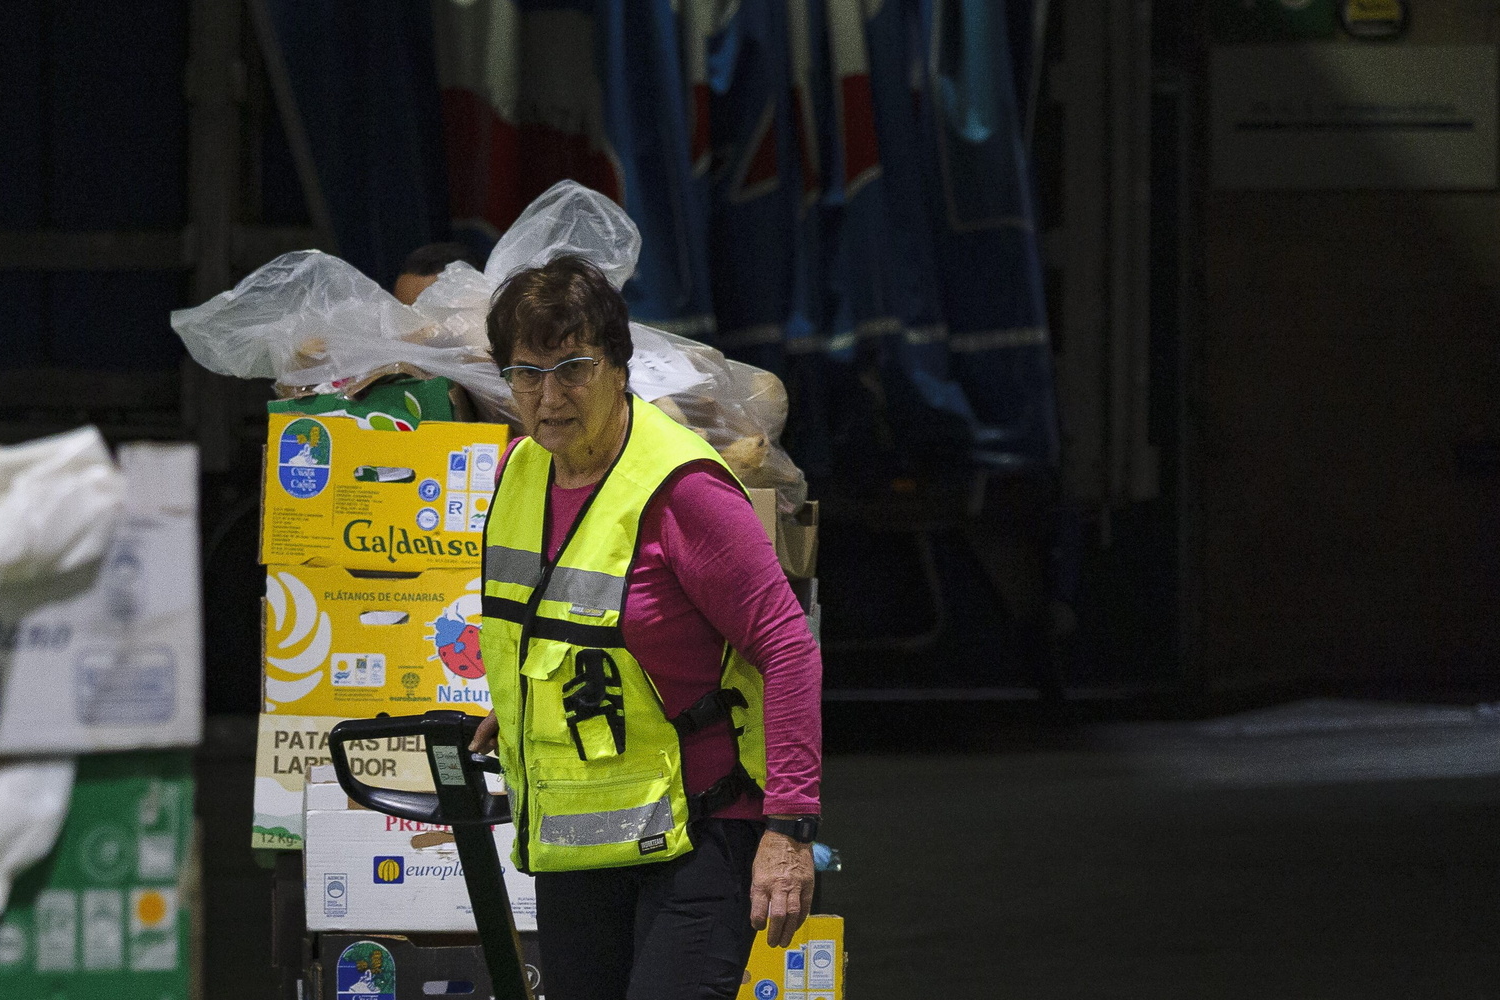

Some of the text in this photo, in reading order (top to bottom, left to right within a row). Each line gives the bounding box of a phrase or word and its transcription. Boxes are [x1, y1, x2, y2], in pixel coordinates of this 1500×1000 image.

[343, 519, 480, 564] Galdense
[324, 590, 445, 603] PLÁTANOS DE CANARIAS
[274, 731, 380, 751] PATAAS
[273, 755, 397, 777] LADOR
[406, 861, 506, 880] europlo
